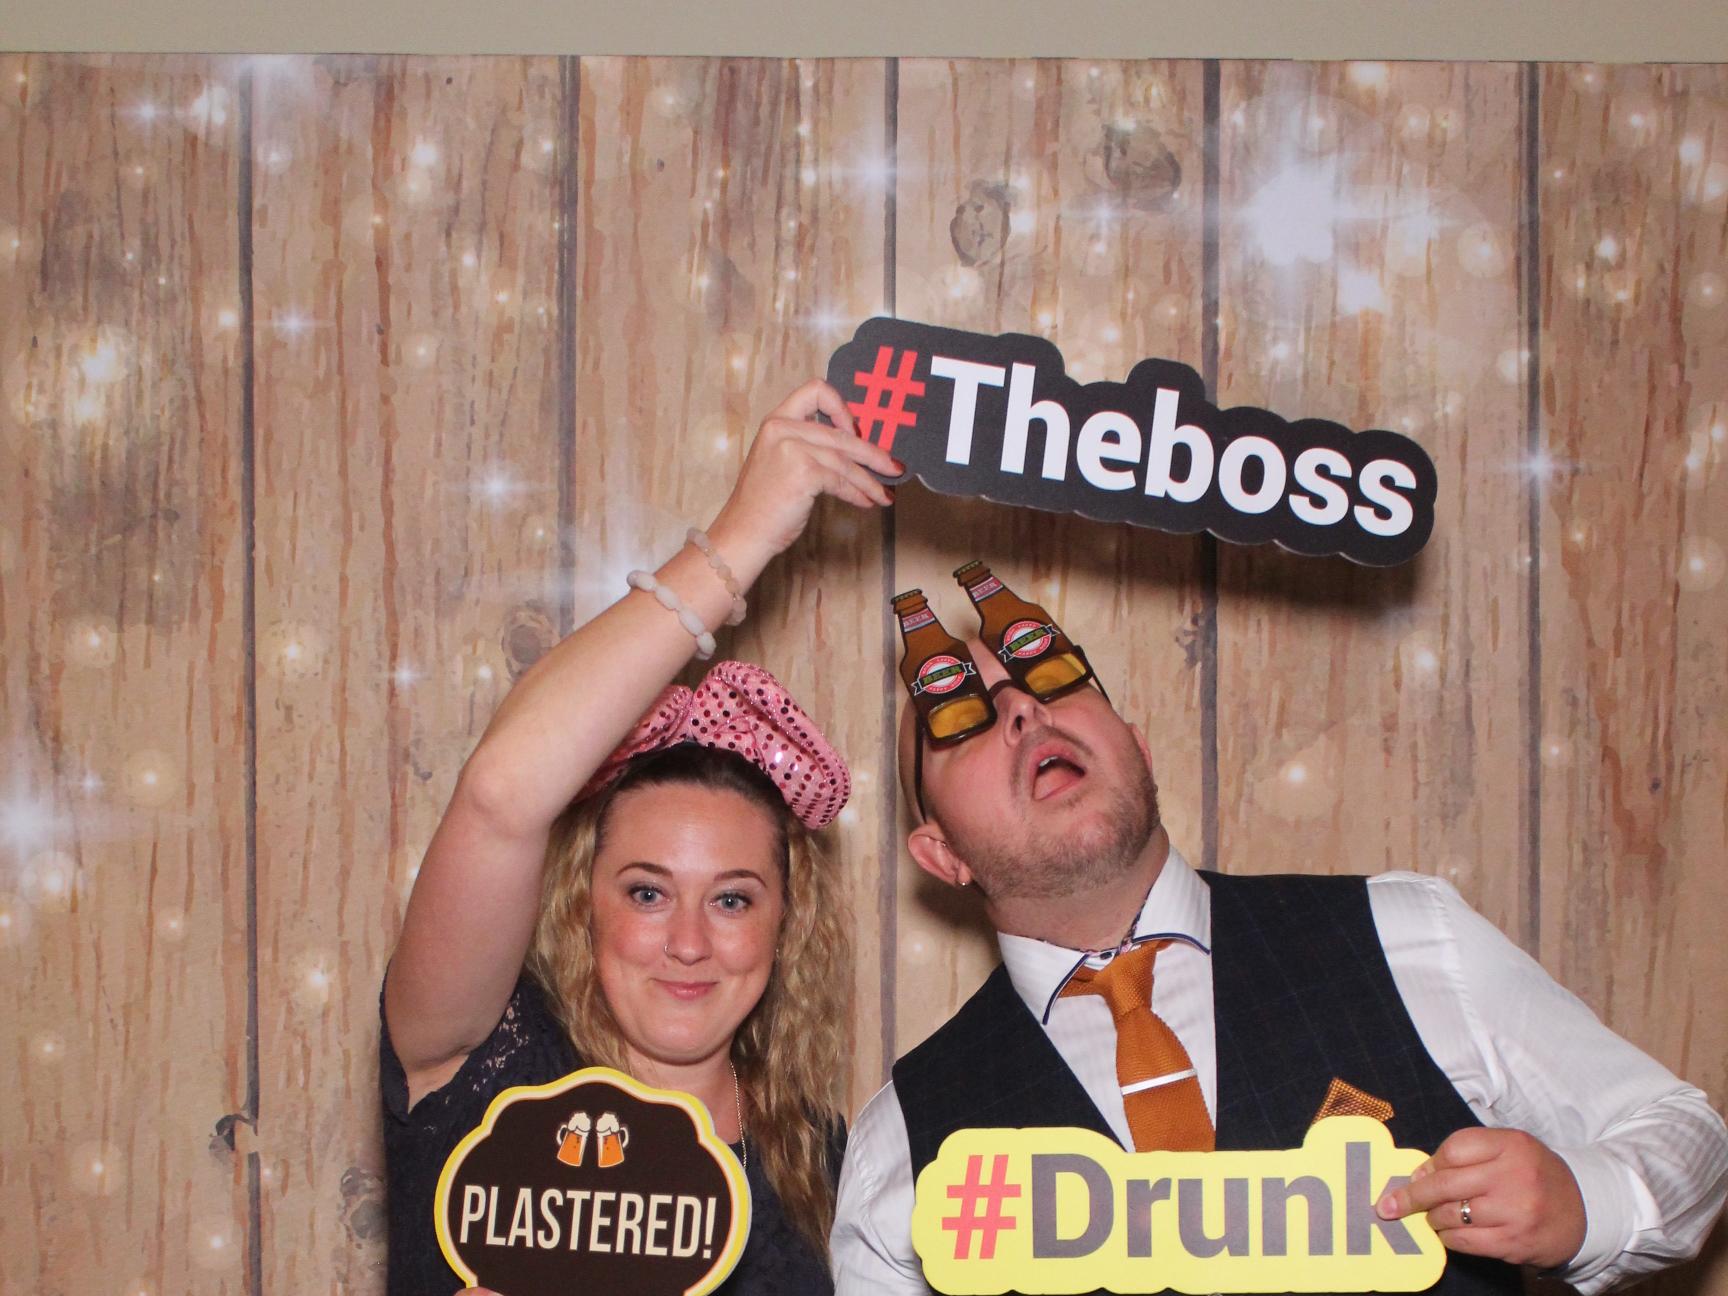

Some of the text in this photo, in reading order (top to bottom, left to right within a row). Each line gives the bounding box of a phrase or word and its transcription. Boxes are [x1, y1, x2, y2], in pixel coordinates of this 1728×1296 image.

[849, 346, 1417, 536] #Theboss
[459, 1184, 717, 1259] PLASTERED!
[941, 1141, 1423, 1260] #Drunk
